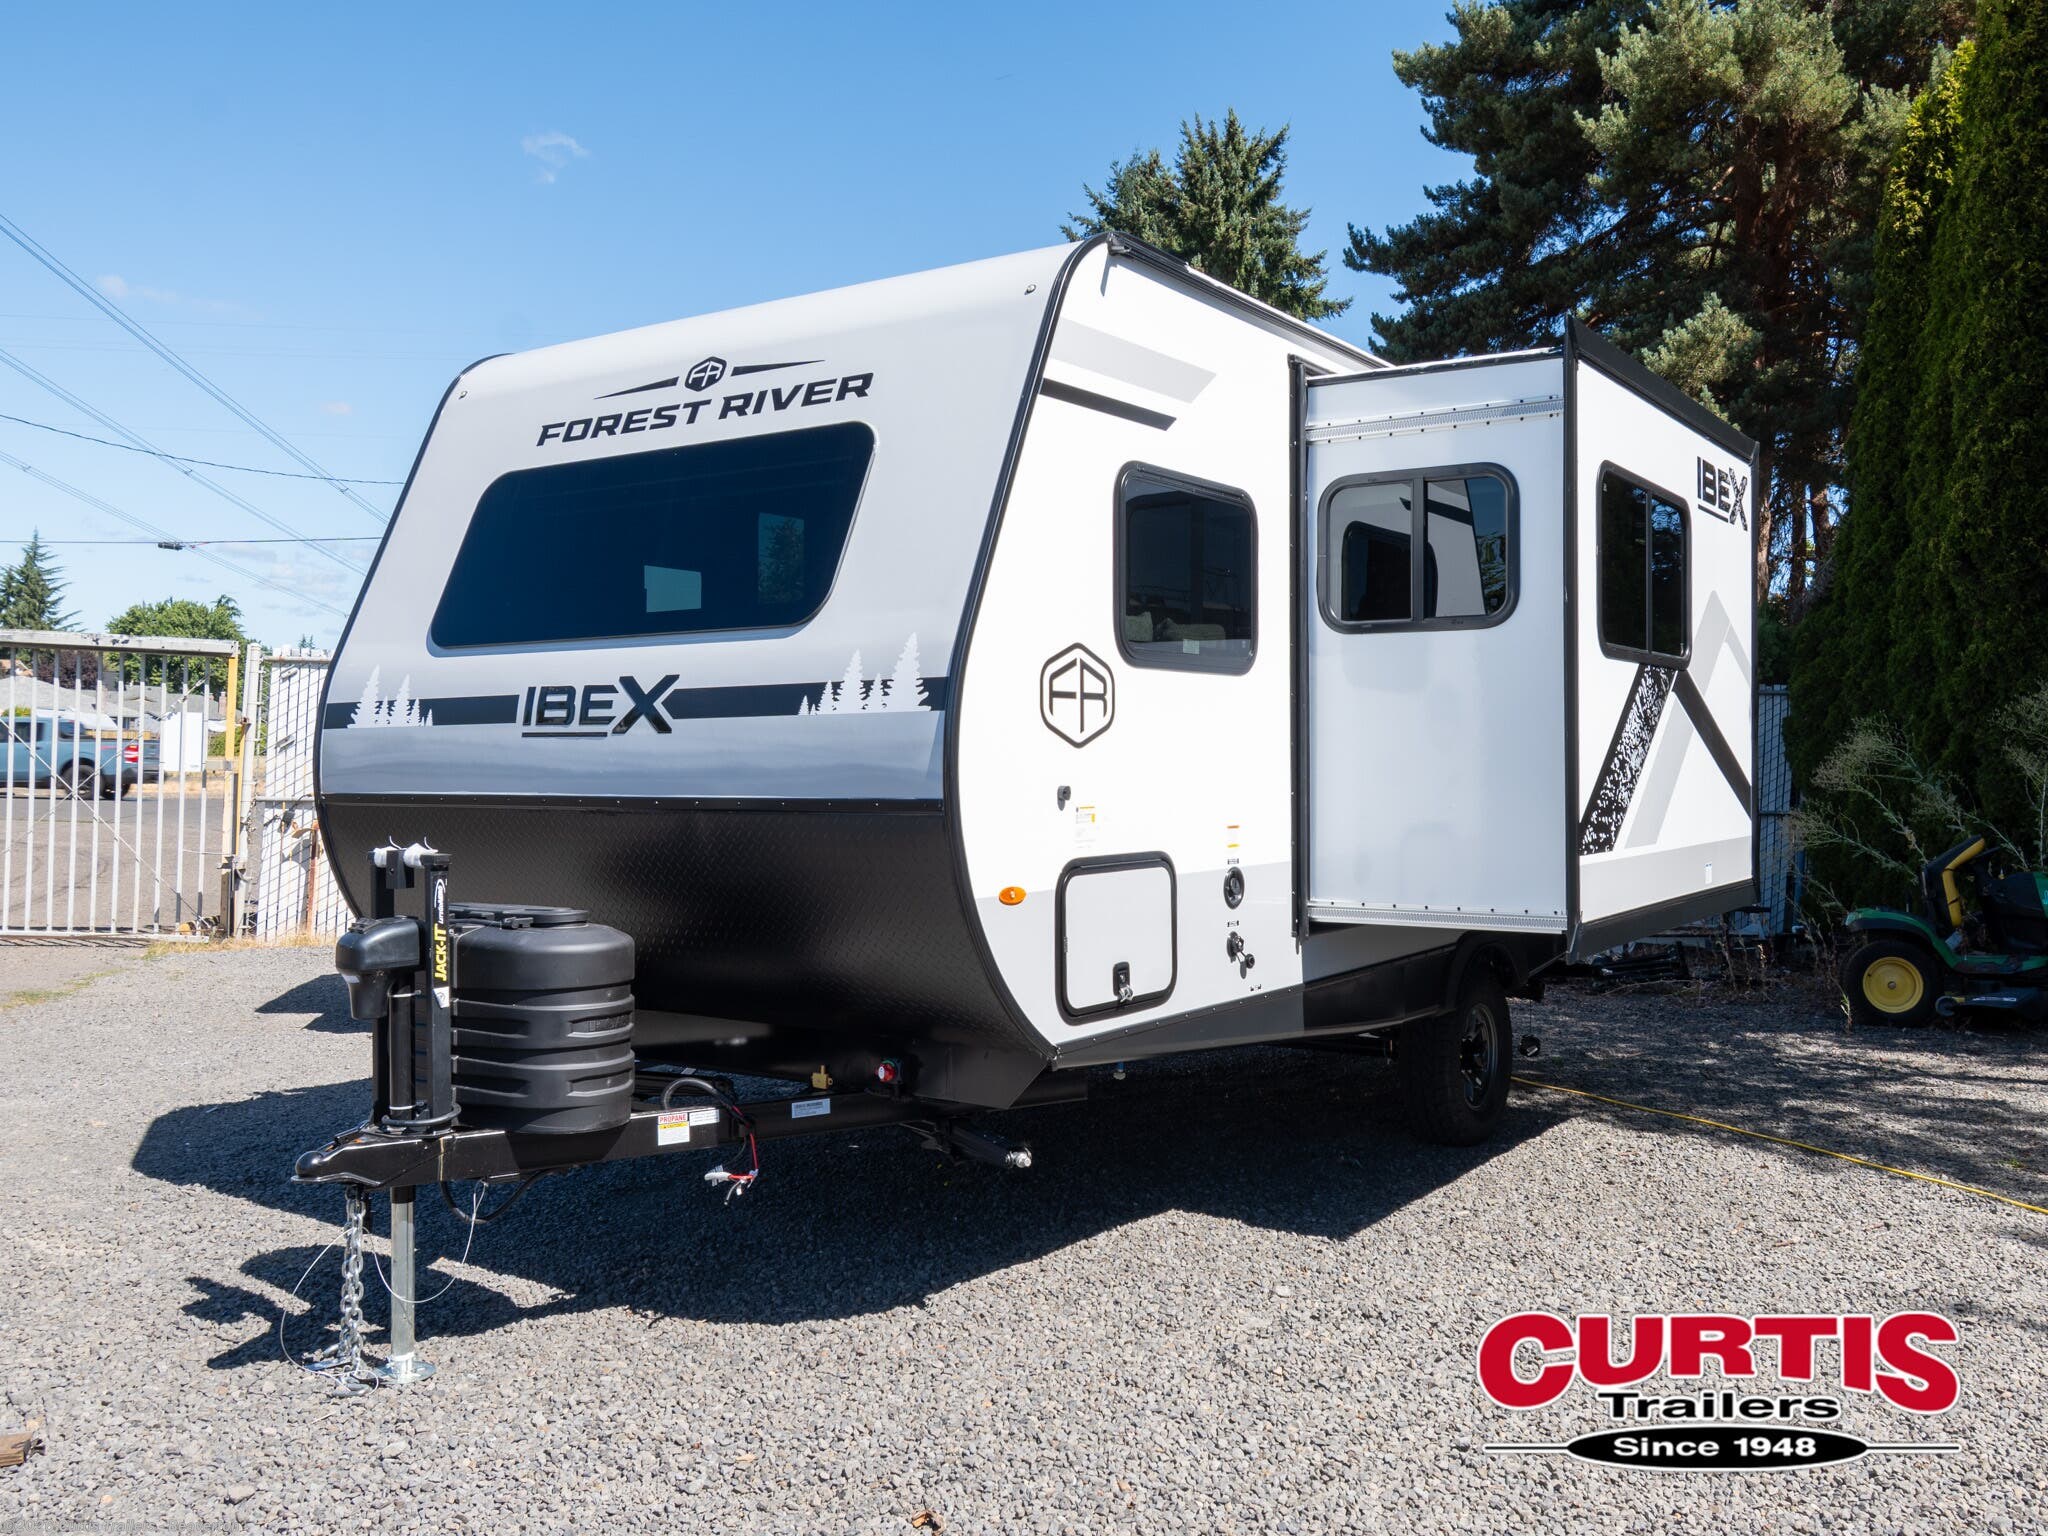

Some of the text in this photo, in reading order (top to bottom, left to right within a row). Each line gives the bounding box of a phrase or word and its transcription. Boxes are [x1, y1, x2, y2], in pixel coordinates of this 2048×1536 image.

[537, 372, 874, 447] FOREST RIVER
[1696, 456, 1749, 532] IBEX
[521, 674, 681, 735] IBEX
[433, 923, 447, 982] JACK-IT
[659, 1113, 687, 1123] PROPANE
